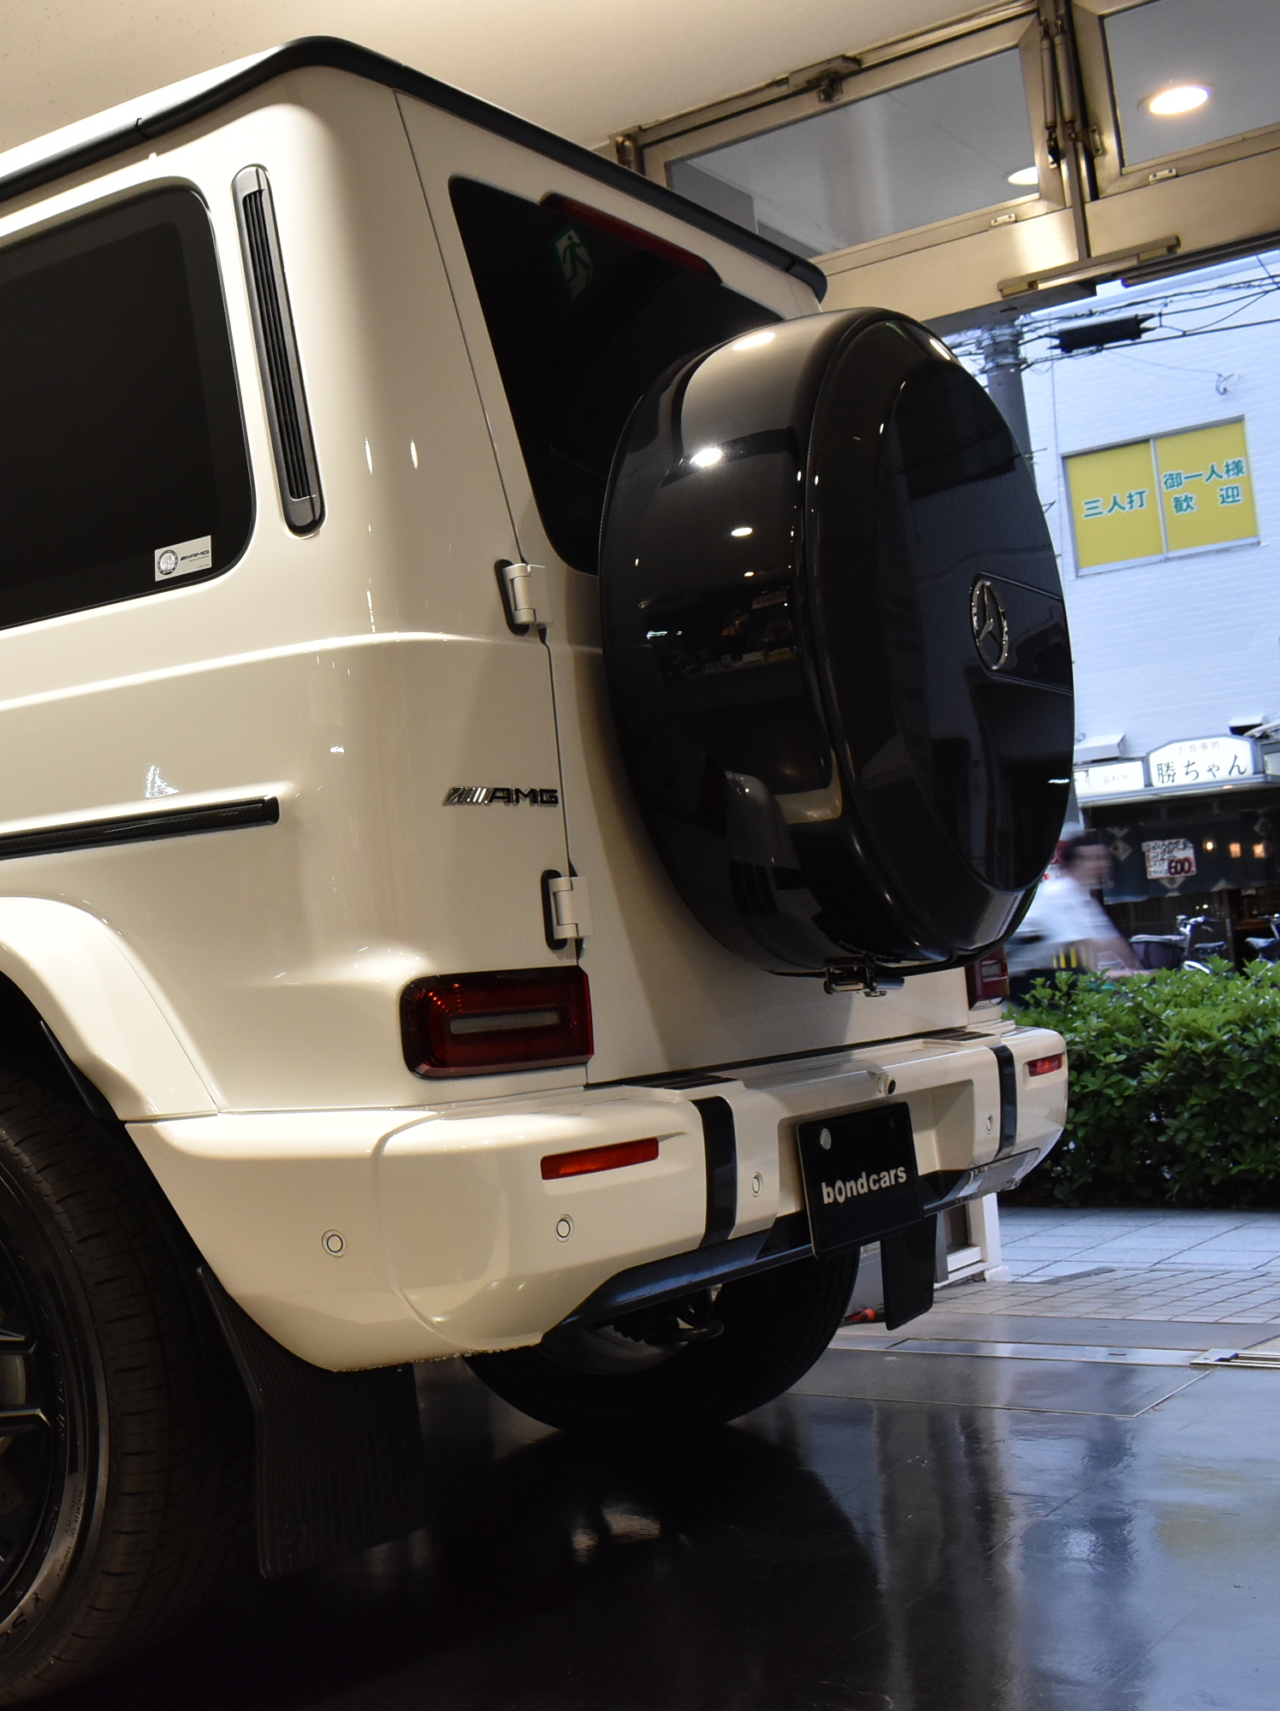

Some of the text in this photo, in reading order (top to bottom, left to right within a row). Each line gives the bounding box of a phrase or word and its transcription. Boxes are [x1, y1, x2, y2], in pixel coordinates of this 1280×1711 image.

[1163, 459, 1245, 490] 御一人様
[1083, 490, 1147, 518] 三人打
[1157, 754, 1247, 785] 勝ちゃん
[488, 787, 559, 806] AMG
[1169, 857, 1191, 876] 600
